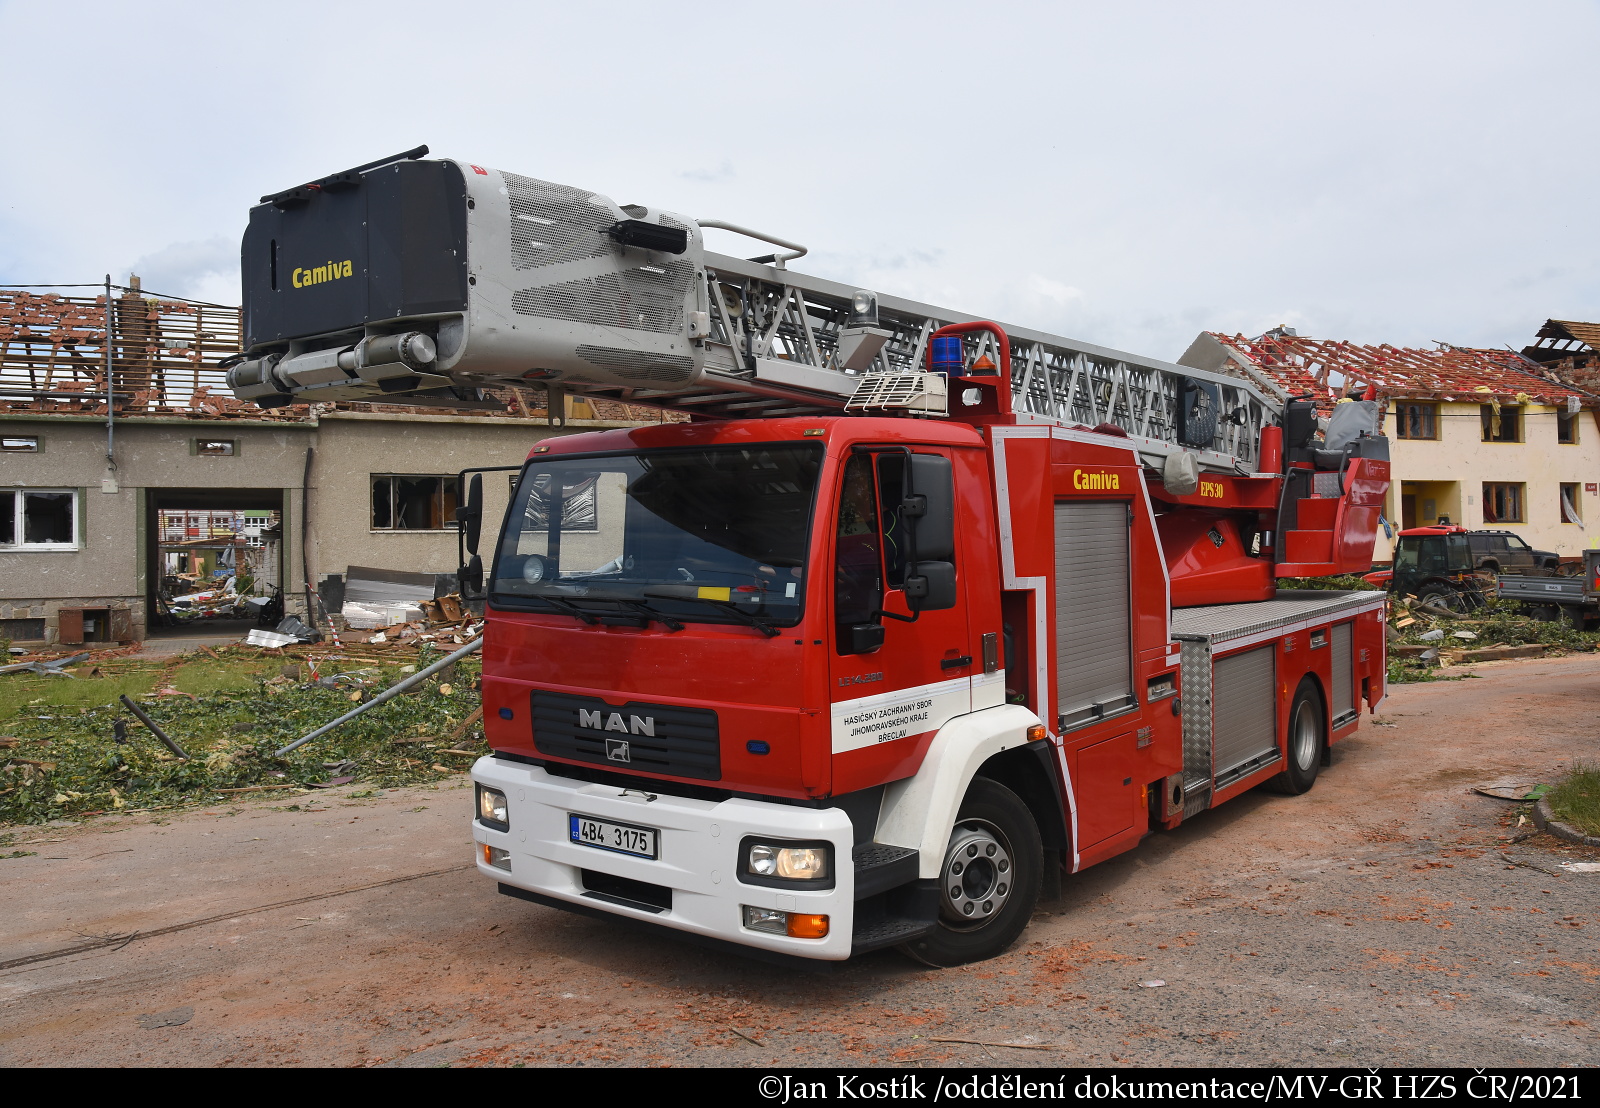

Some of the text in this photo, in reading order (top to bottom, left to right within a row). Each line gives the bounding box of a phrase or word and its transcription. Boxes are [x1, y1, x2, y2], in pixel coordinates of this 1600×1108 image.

[292, 259, 354, 289] Camiva
[1073, 469, 1119, 490] Camiva
[1200, 481, 1224, 498] EPS 30
[579, 708, 655, 737] MAN
[844, 699, 932, 726] HASIČSKÝ ZÁCHRANNÝ SBOR
[850, 711, 928, 737] JIHOMORAVSKÉHO KRAJE
[878, 729, 907, 743] BŘECLAV
[581, 821, 648, 851] 4B4 3175
